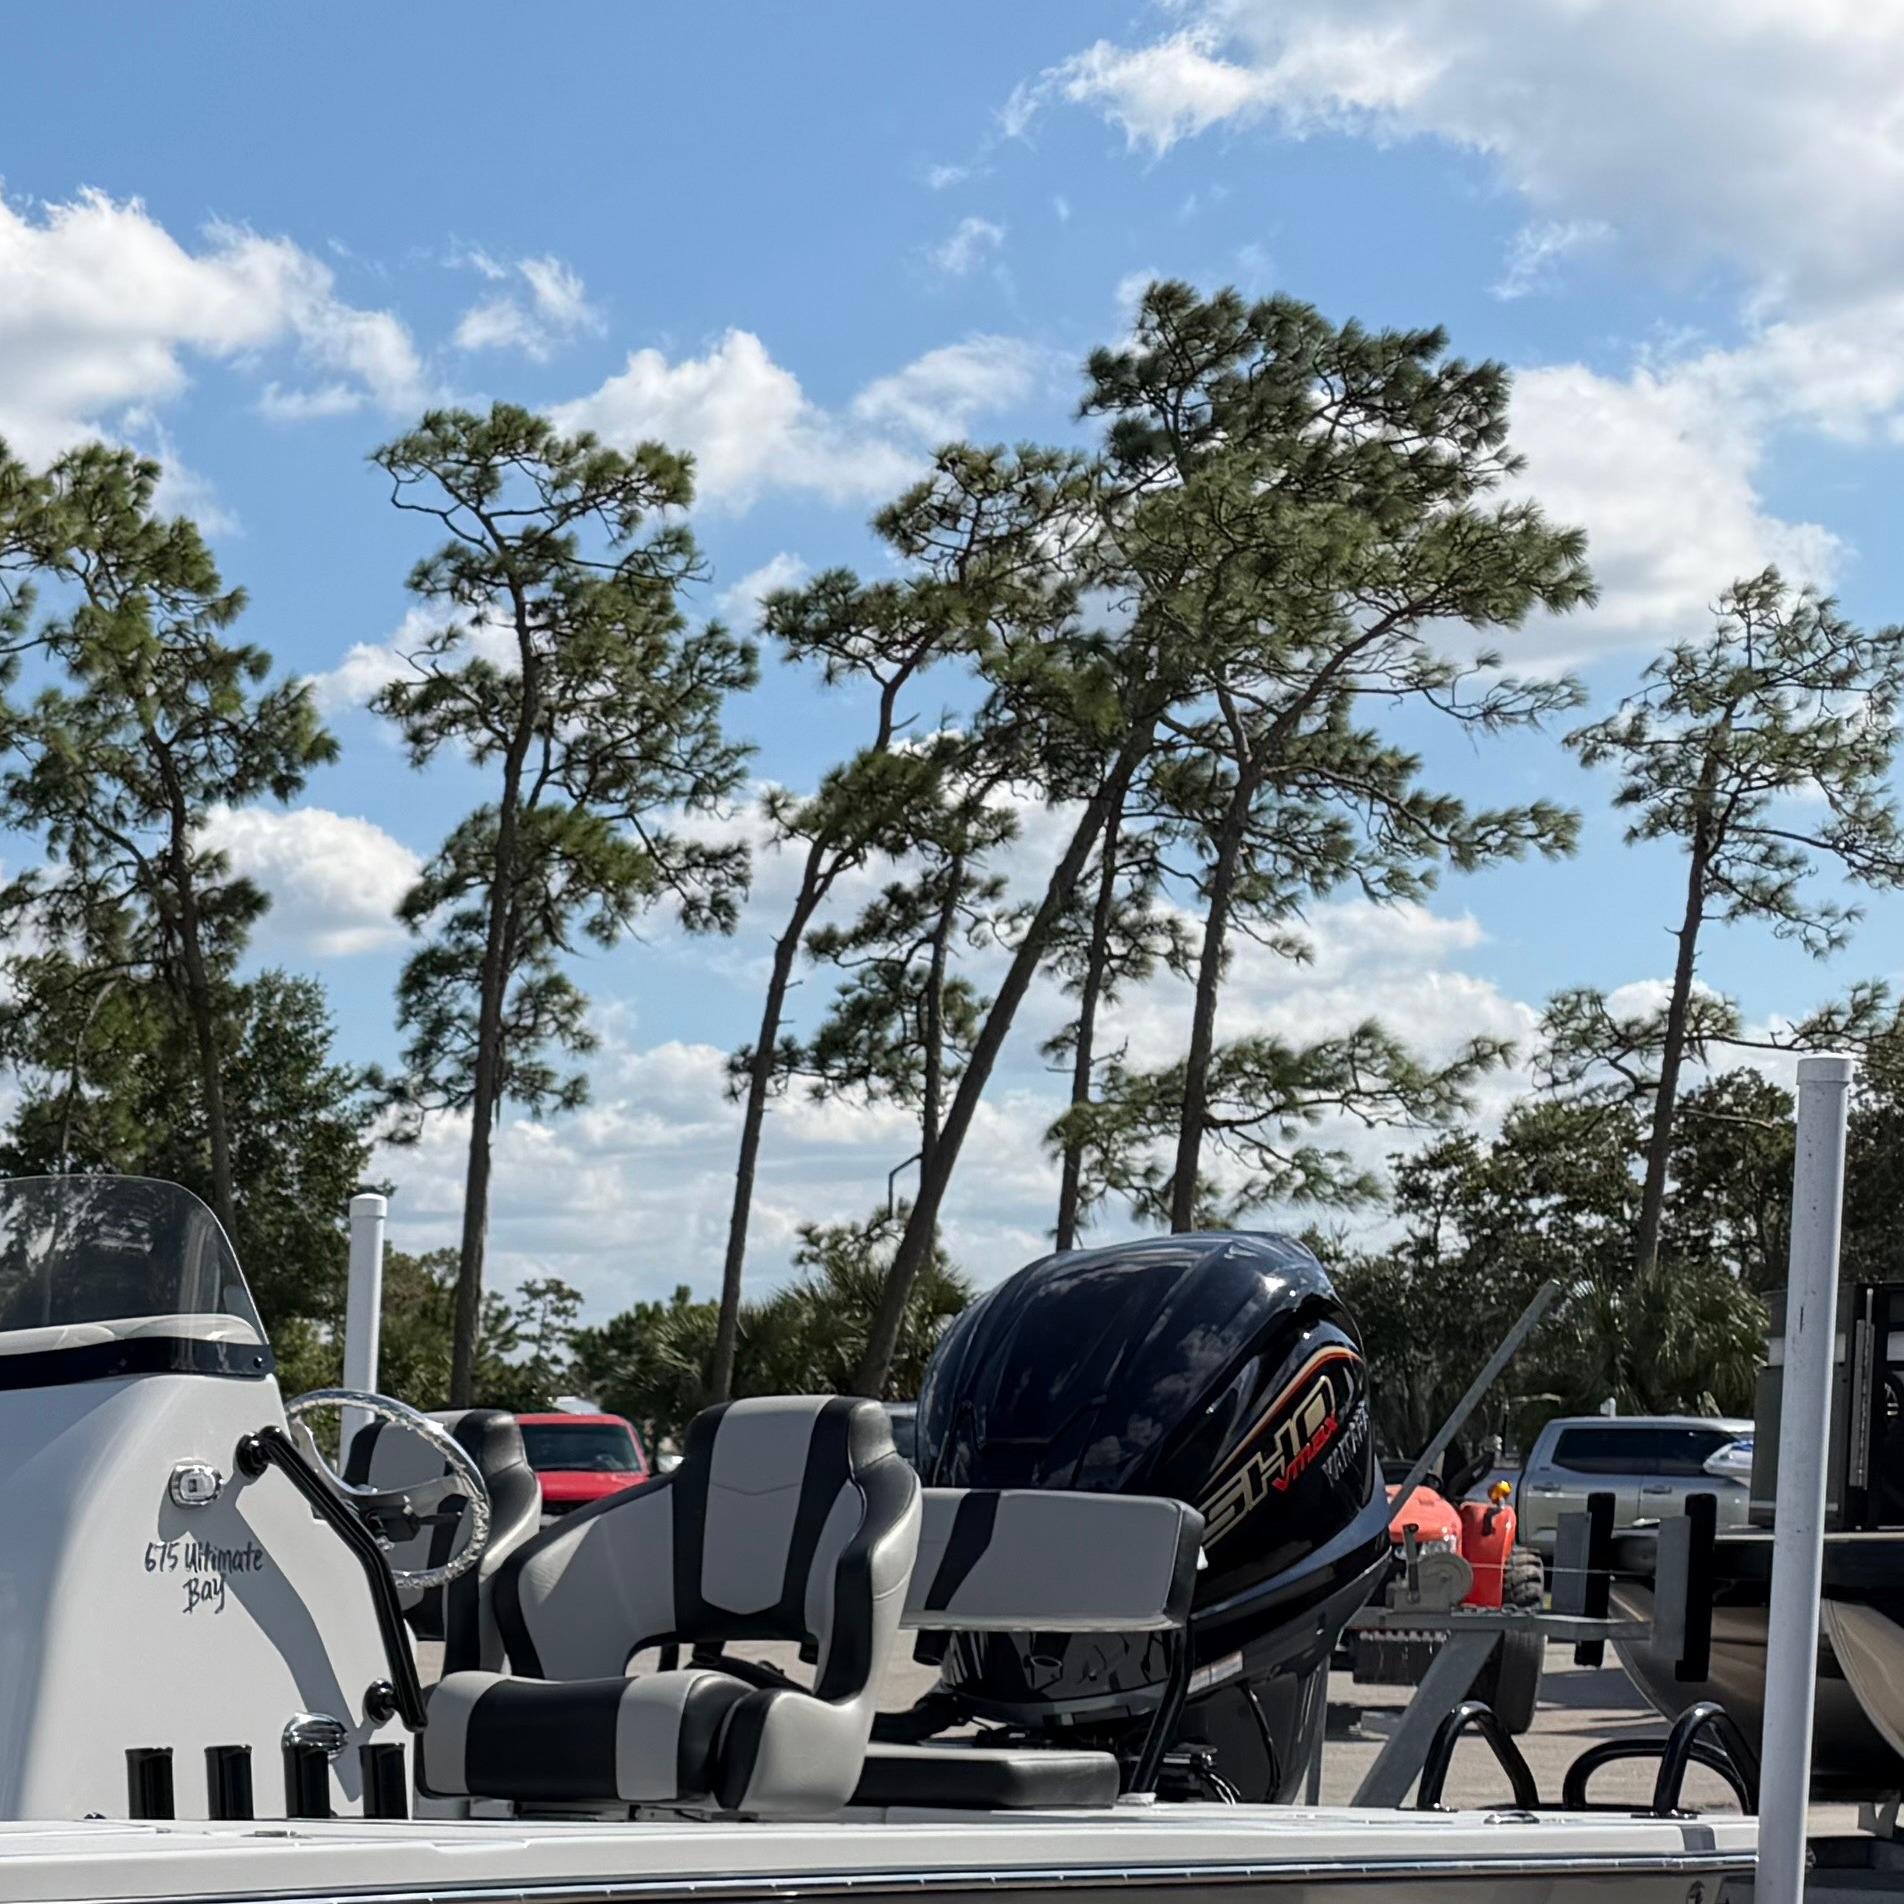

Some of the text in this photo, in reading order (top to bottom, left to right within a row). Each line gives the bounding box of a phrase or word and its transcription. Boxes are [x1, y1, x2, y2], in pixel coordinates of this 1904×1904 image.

[1197, 1374, 1336, 1550] SHO
[144, 1540, 264, 1574] 675 Ultimate
[182, 1572, 227, 1615] Bay
